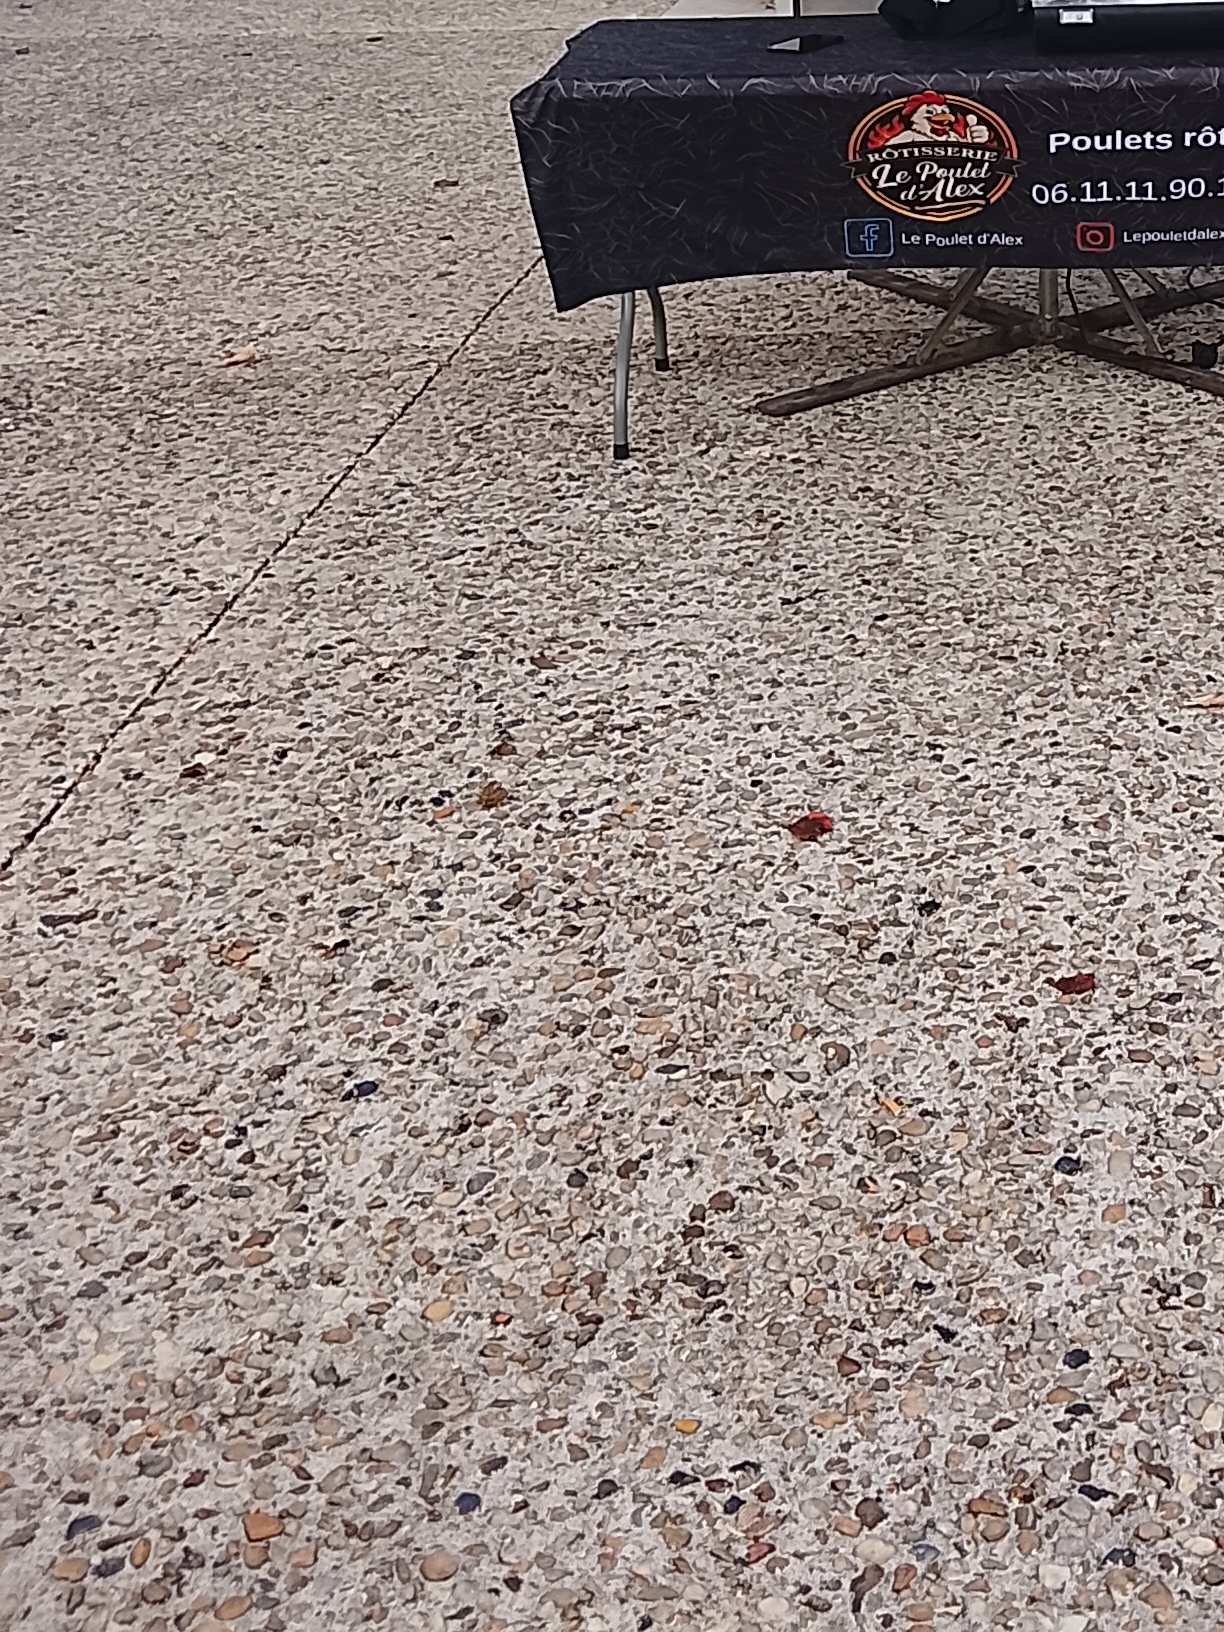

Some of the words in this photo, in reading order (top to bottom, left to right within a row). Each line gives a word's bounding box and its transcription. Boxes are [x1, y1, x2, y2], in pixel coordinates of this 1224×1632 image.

[1049, 130, 1173, 153] Poulets
[866, 146, 998, 164] RÔTISSERIE
[871, 163, 912, 189] Le
[915, 160, 992, 183] Poulet
[900, 176, 986, 203] d'Alex
[901, 233, 921, 245] Le
[925, 233, 973, 247] Poulet
[977, 232, 1024, 246] d'Alex
